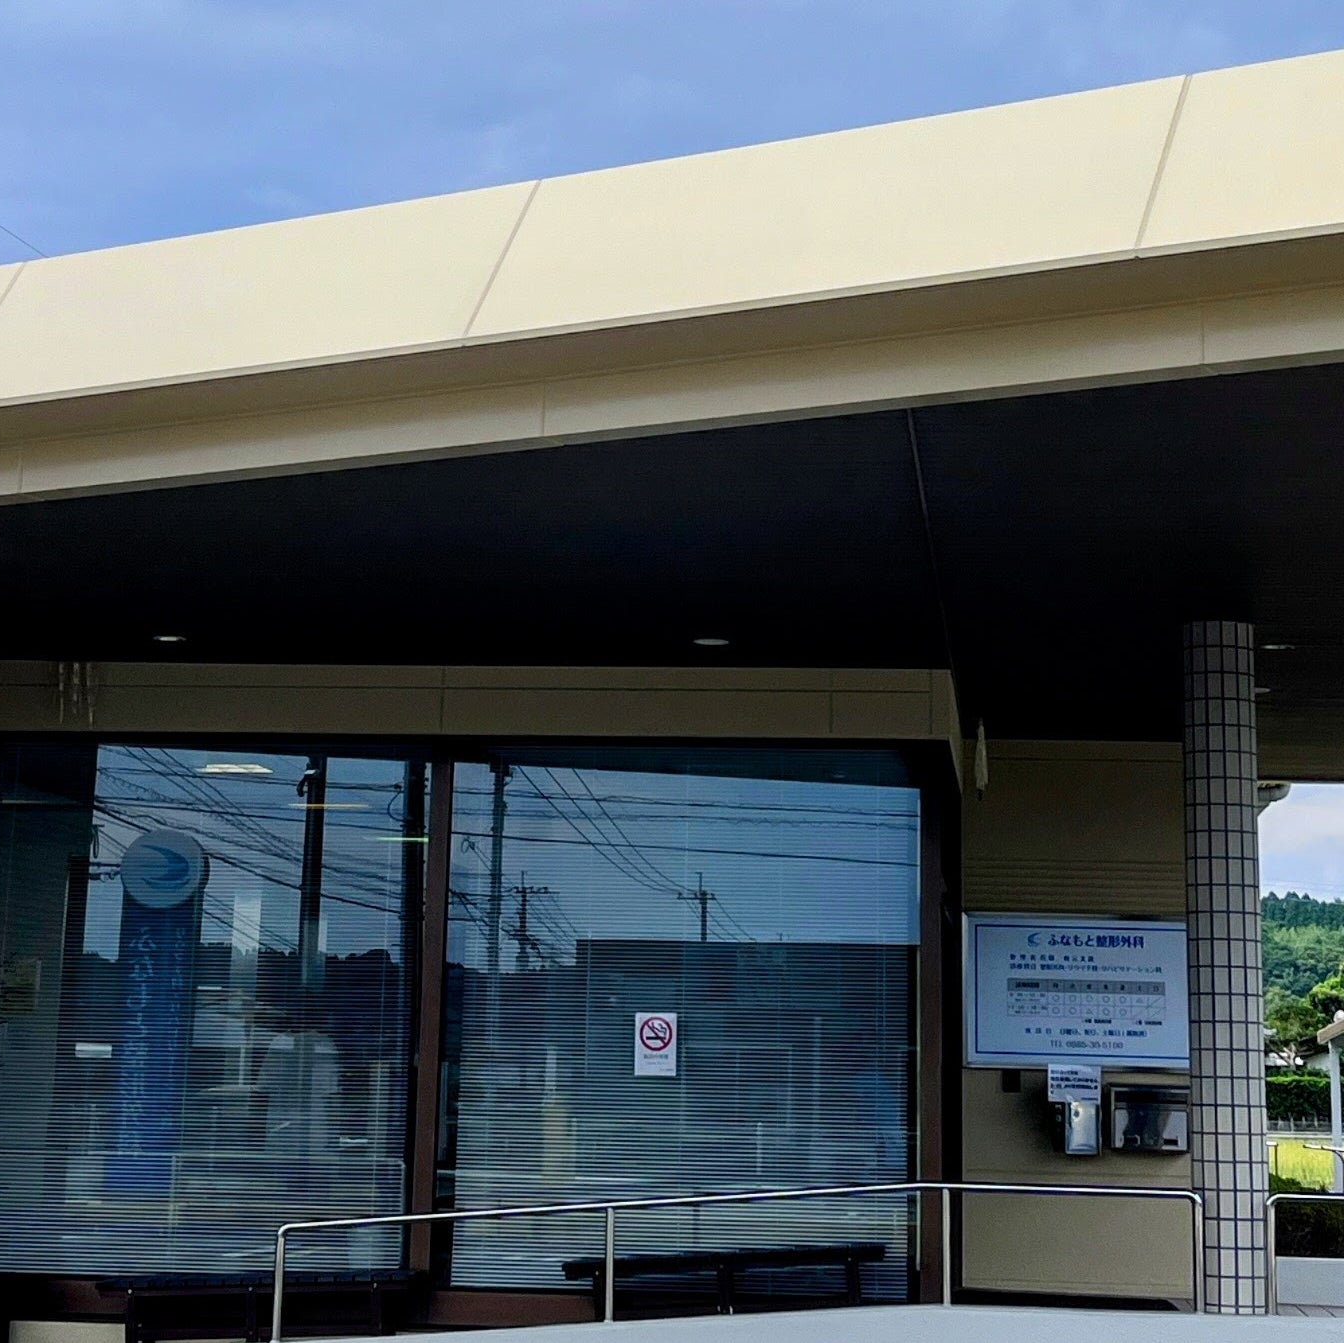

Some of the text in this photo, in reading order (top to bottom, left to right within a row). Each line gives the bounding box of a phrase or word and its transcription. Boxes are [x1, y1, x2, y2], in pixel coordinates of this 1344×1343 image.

[1048, 934, 1144, 949] ふなもと整形外科
